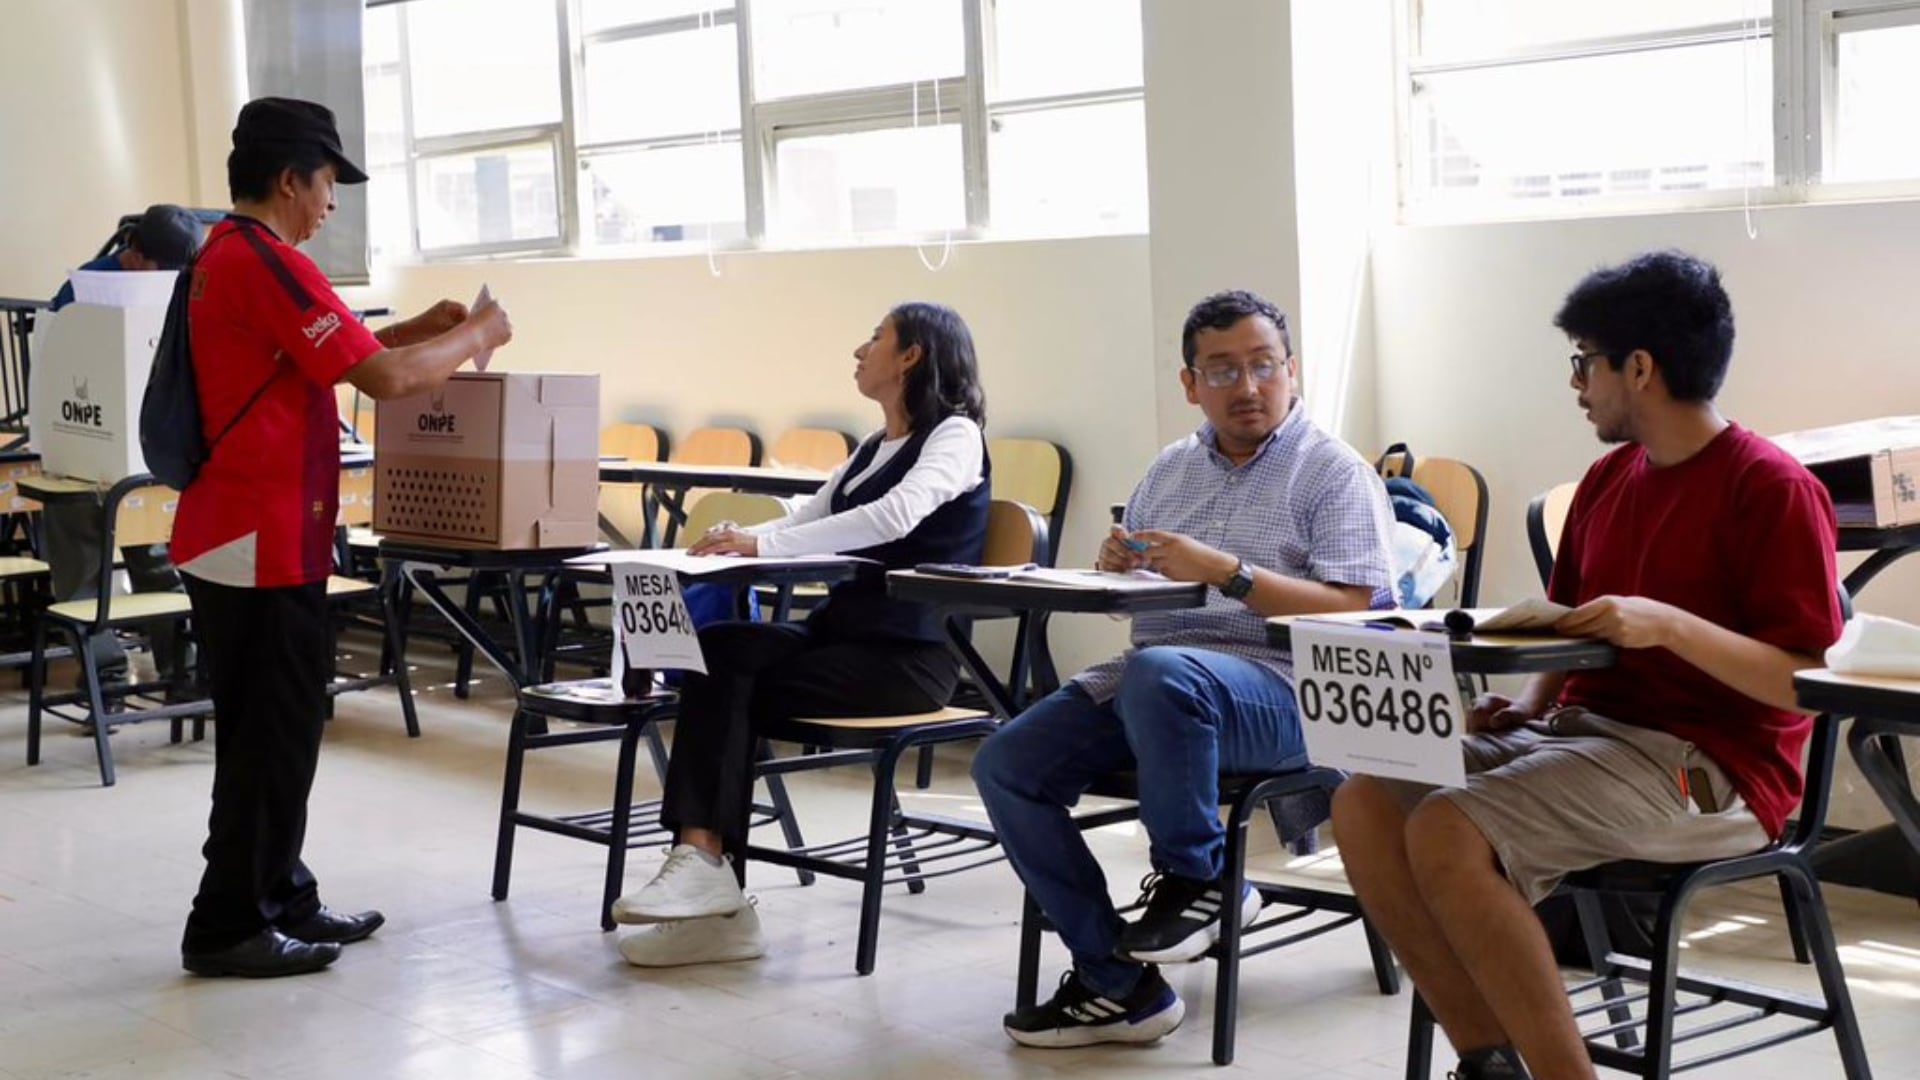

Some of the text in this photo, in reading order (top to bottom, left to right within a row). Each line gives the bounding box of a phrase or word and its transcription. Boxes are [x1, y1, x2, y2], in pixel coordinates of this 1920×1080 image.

[302, 311, 338, 339] beko
[62, 400, 102, 427] ONPE
[418, 413, 456, 433] ONPE
[625, 574, 674, 596] MESA
[1311, 644, 1394, 680] MESA
[1300, 678, 1453, 738] 036486
